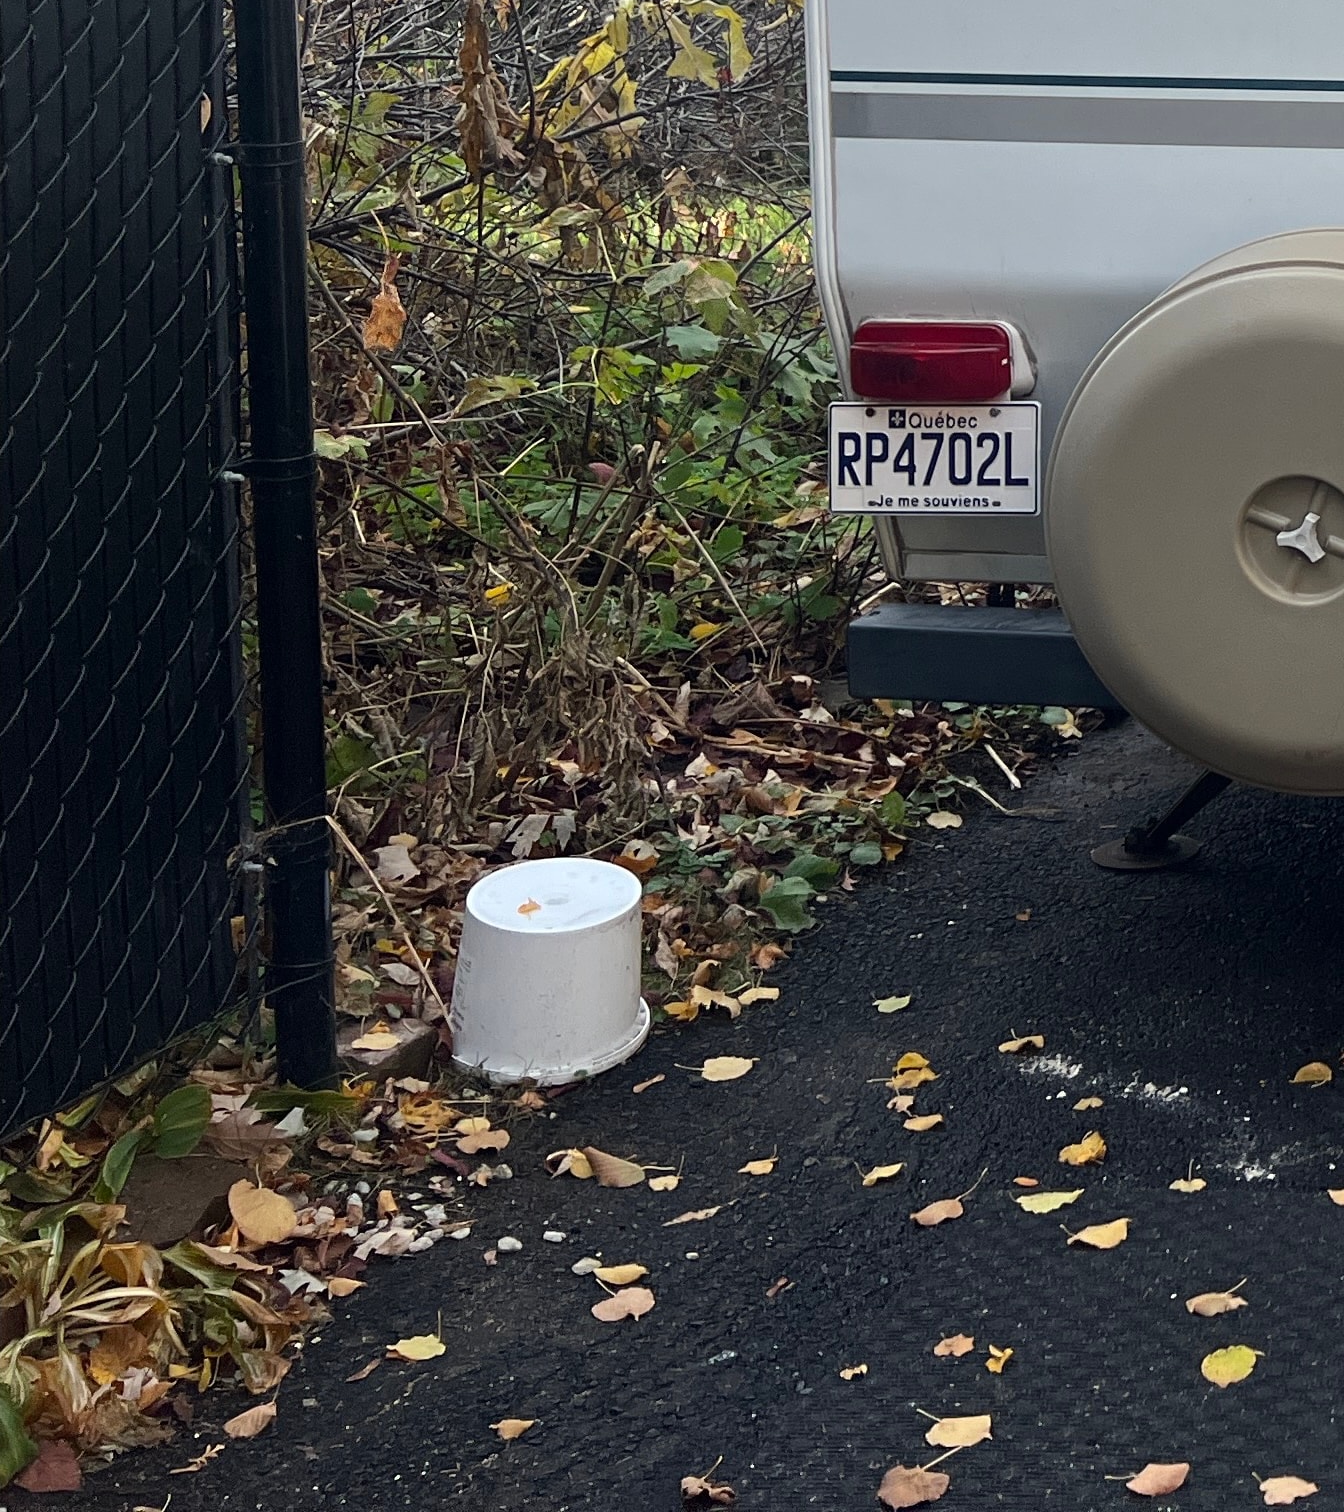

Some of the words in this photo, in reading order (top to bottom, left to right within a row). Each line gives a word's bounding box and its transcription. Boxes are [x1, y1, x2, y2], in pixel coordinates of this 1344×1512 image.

[908, 410, 978, 429] Québec
[838, 432, 1029, 486] RP4702L
[877, 494, 893, 507] Je
[898, 496, 919, 507] me
[923, 495, 989, 507] souviens
